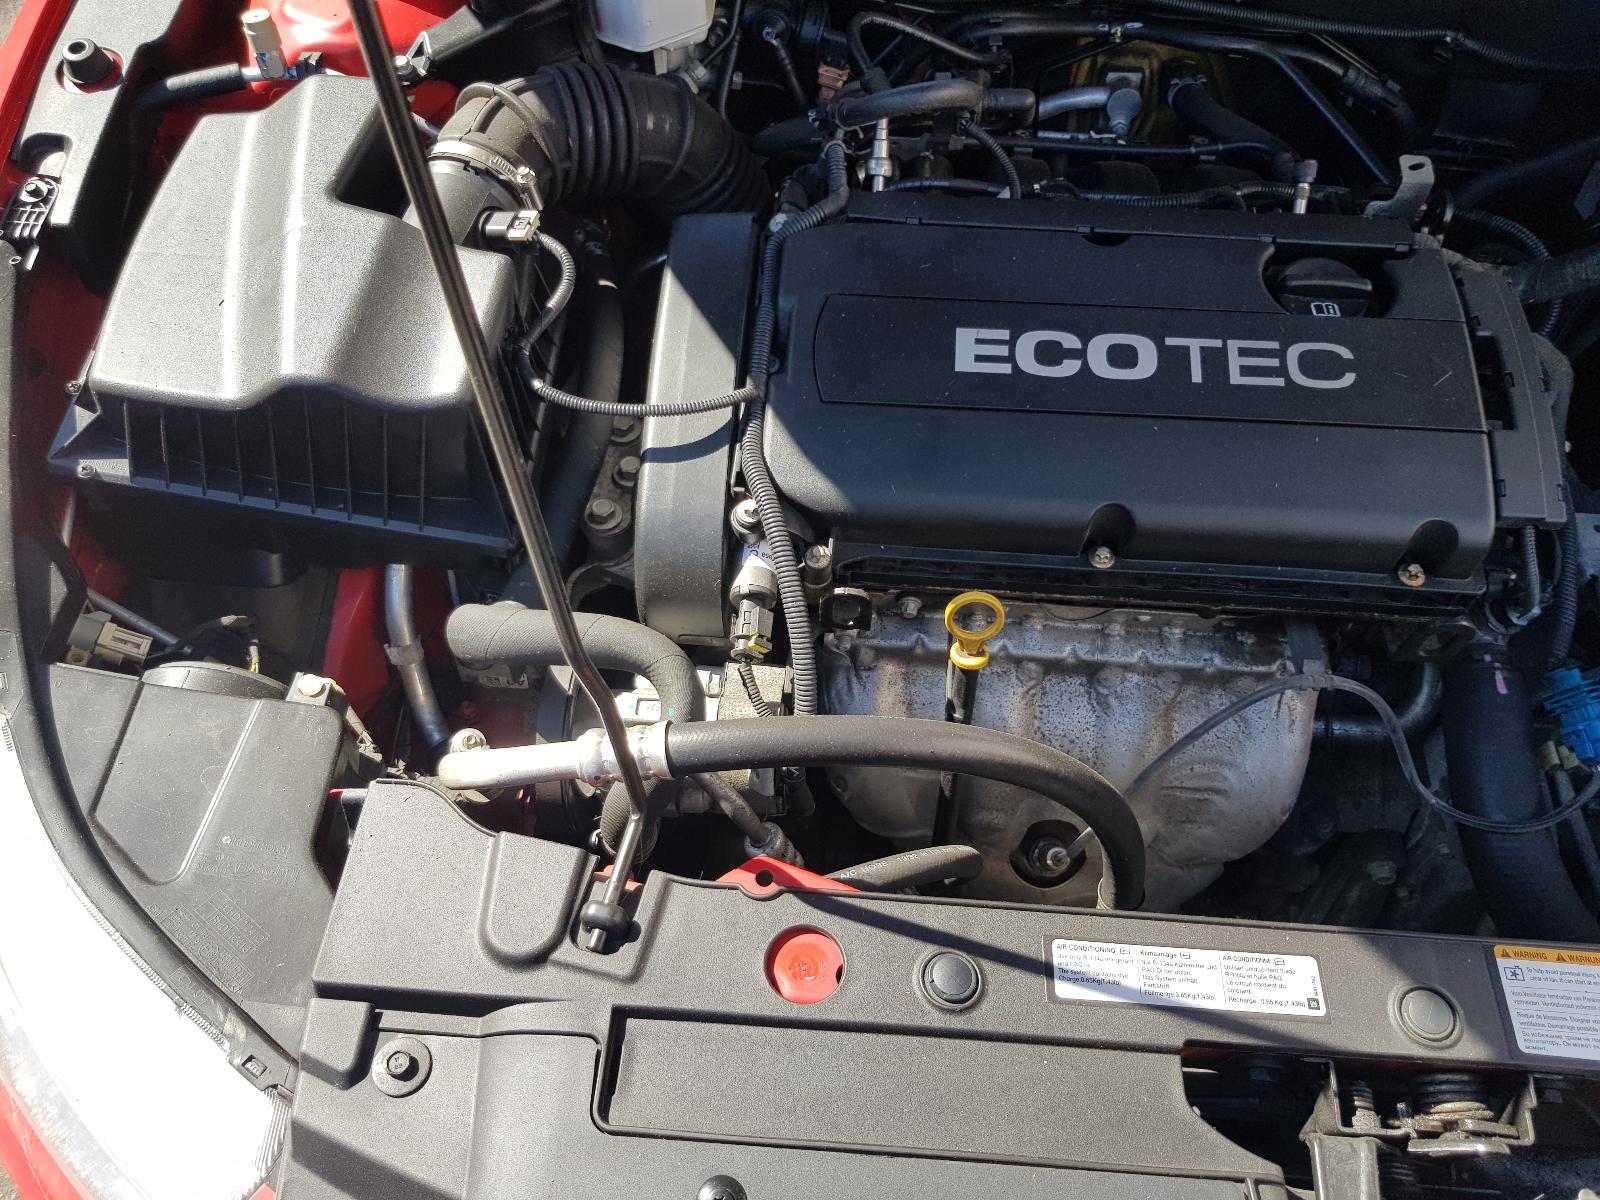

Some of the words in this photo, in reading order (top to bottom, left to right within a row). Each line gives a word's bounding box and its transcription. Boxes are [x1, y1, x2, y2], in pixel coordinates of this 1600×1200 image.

[955, 327, 1356, 388] ECOTEC
[1068, 944, 1116, 954] CONDITIONING
[1140, 950, 1177, 960] Klimaanlage
[1512, 951, 1548, 960] WARNING
[1567, 954, 1600, 964] WARNUN
[1058, 967, 1069, 975] The
[1155, 974, 1177, 982] System
[1228, 996, 1257, 1004] Recharge
